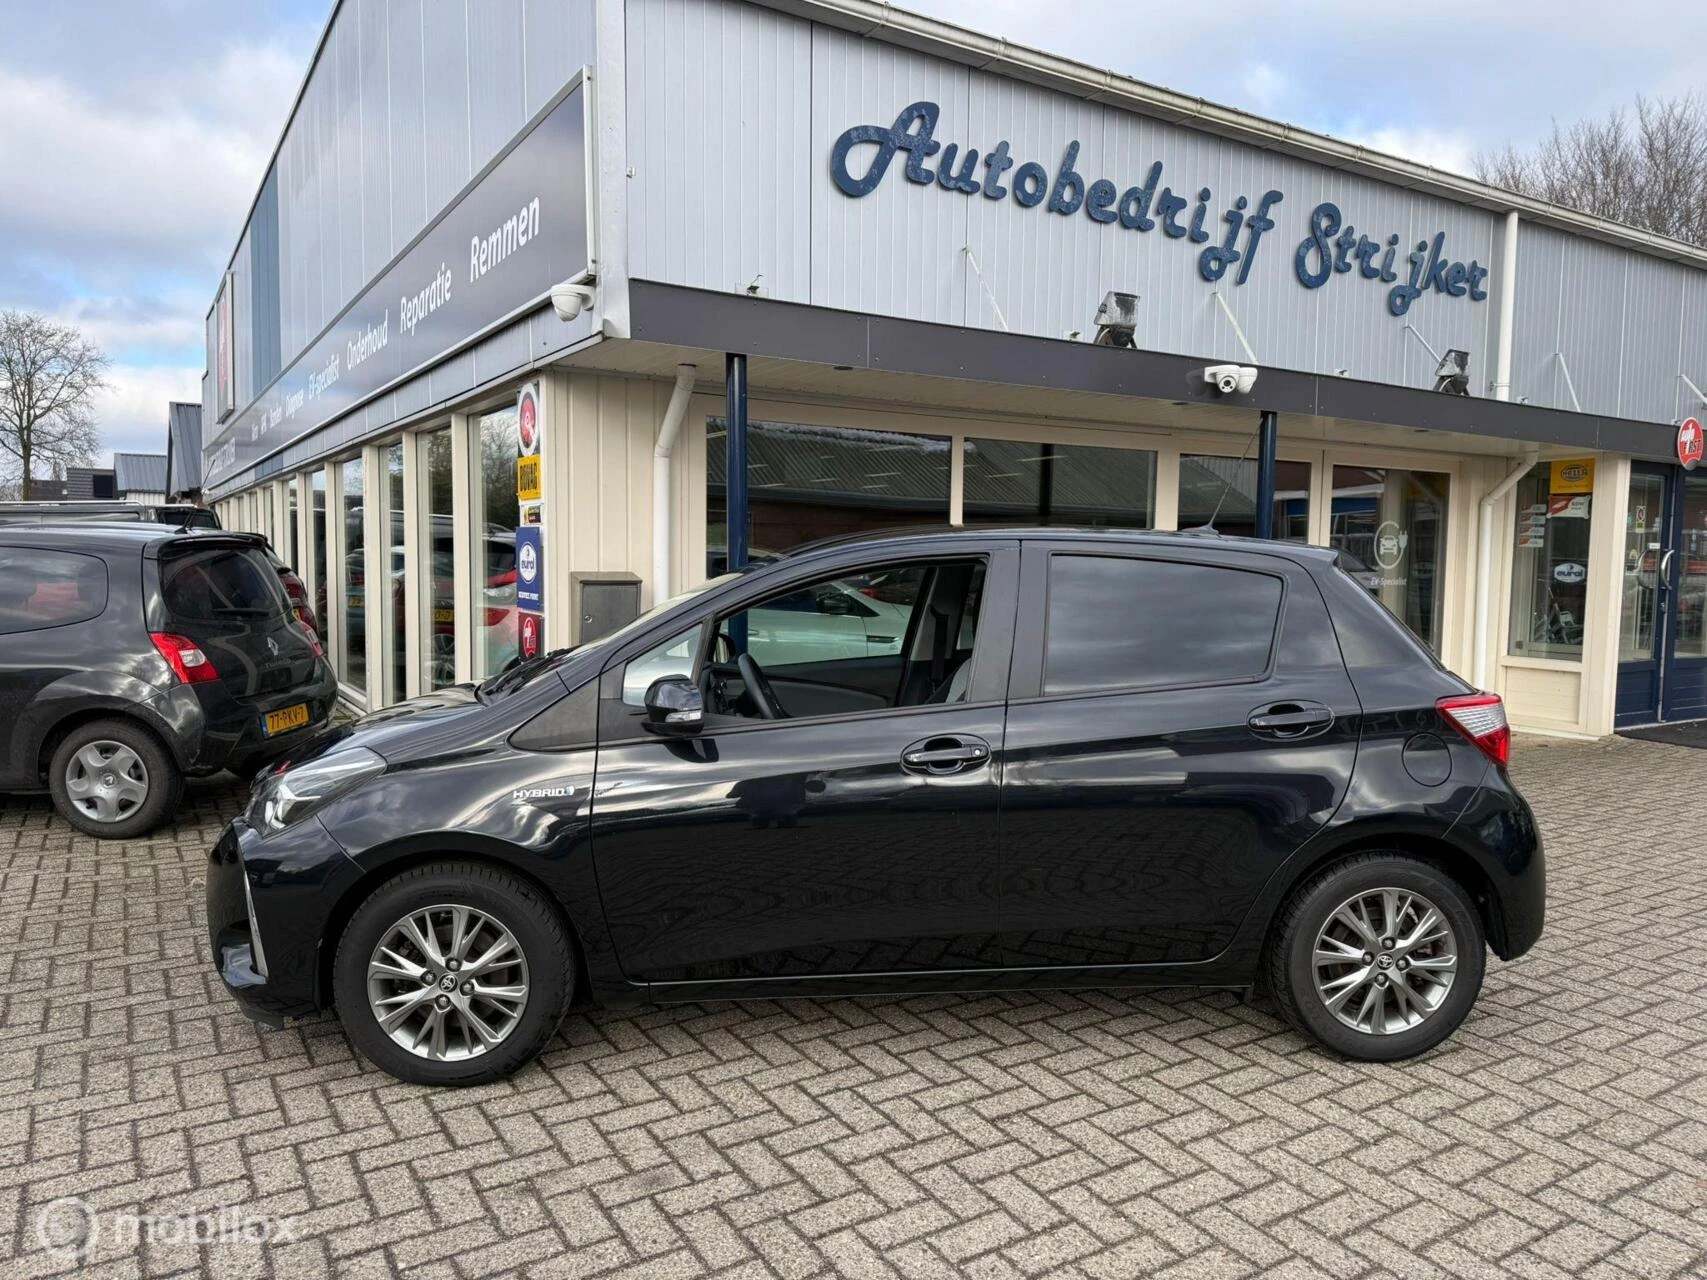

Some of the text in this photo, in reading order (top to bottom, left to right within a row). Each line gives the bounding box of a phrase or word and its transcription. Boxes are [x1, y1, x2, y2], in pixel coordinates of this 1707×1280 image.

[831, 101, 1488, 316] Autobedrijf Strijker
[347, 309, 388, 371] Onderhoud
[400, 263, 452, 336] Reparatie
[470, 197, 540, 282] Remmen
[521, 558, 535, 570] eurol
[1556, 566, 1584, 578] eurol
[513, 787, 566, 799] HYBRID
